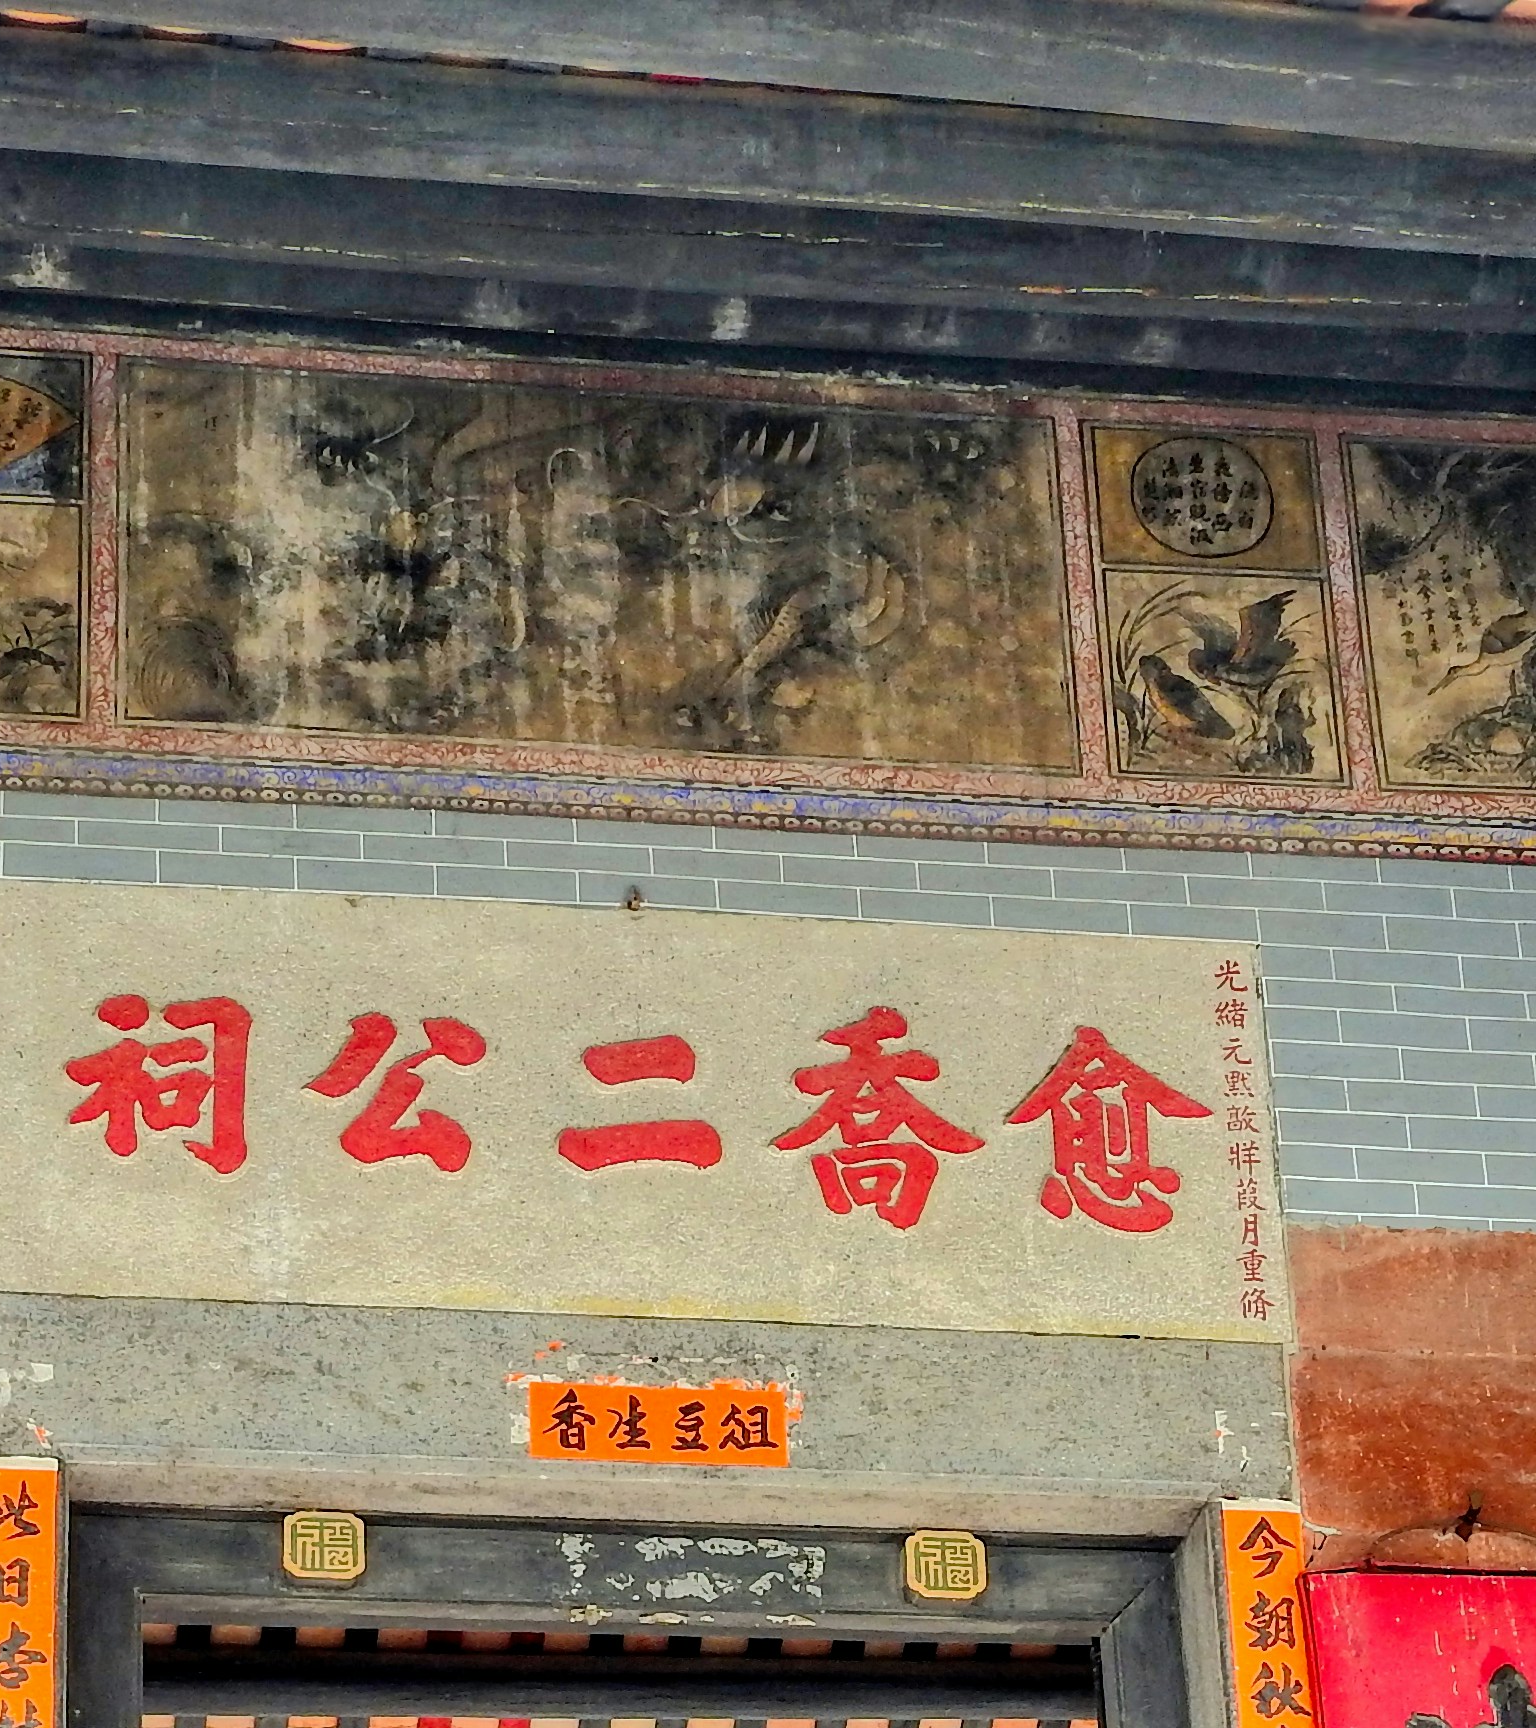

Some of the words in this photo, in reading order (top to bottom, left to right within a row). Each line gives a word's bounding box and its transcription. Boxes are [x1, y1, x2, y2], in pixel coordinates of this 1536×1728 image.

[66, 994, 1213, 1233] 愈喬二公祠
[542, 1388, 779, 1451] 俎豆生香
